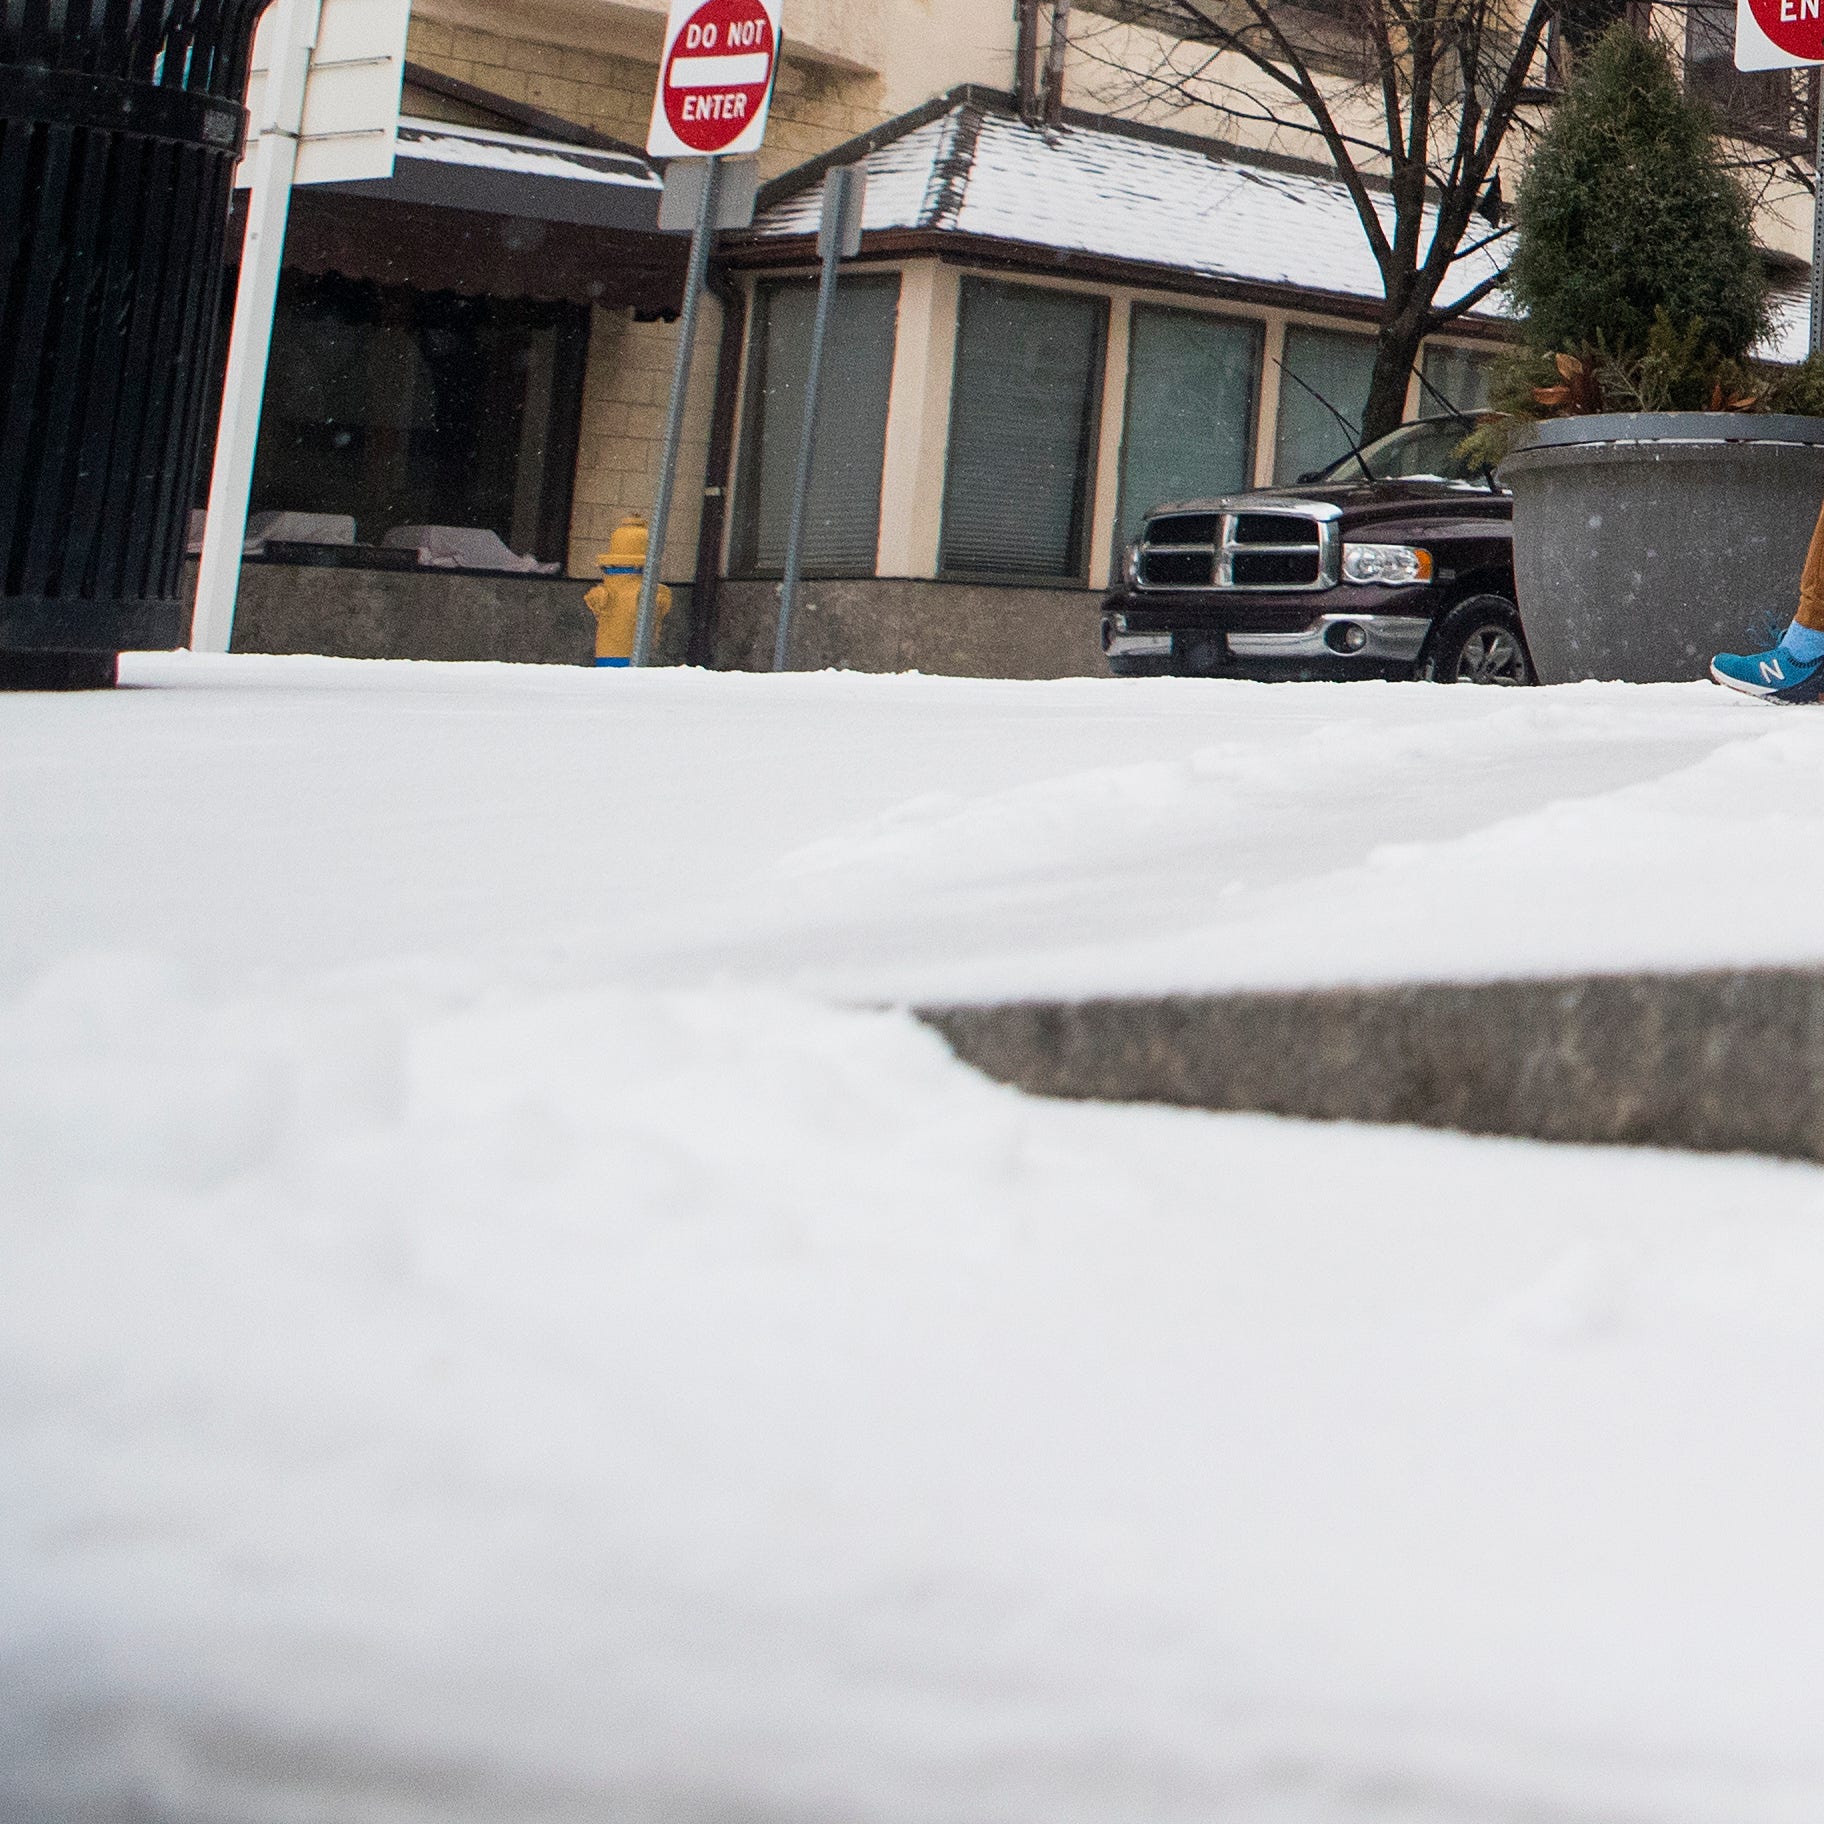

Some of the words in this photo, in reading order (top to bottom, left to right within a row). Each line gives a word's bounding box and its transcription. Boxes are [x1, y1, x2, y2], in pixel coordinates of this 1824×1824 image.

[686, 22, 718, 49] DO
[727, 19, 766, 47] NOT
[682, 93, 748, 121] ENTER
